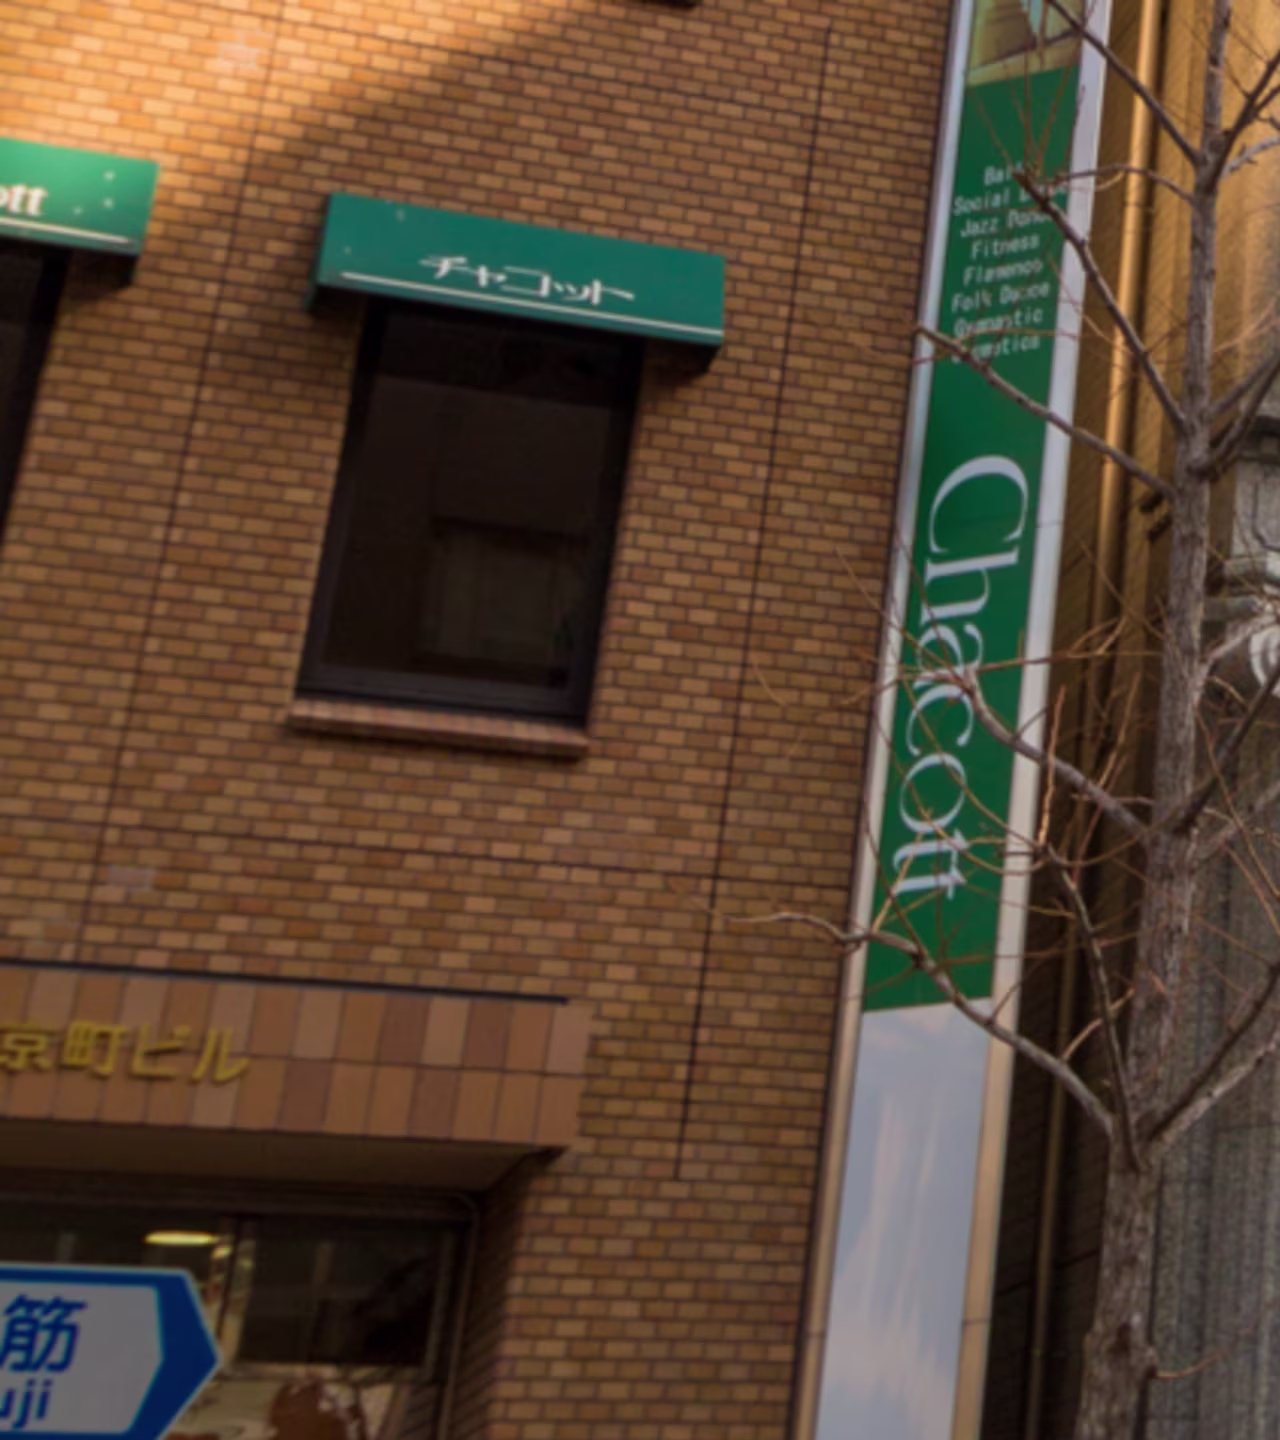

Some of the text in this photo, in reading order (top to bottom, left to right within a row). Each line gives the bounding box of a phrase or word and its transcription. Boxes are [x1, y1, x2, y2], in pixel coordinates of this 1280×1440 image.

[953, 187, 1010, 216] Social
[960, 217, 999, 238] Jazz
[971, 234, 1040, 260] Fitness
[418, 256, 635, 305] チャコット
[892, 454, 1029, 900] Chacott
[0, 1019, 249, 1083] 京町ビル
[0, 1294, 88, 1374] 筋
